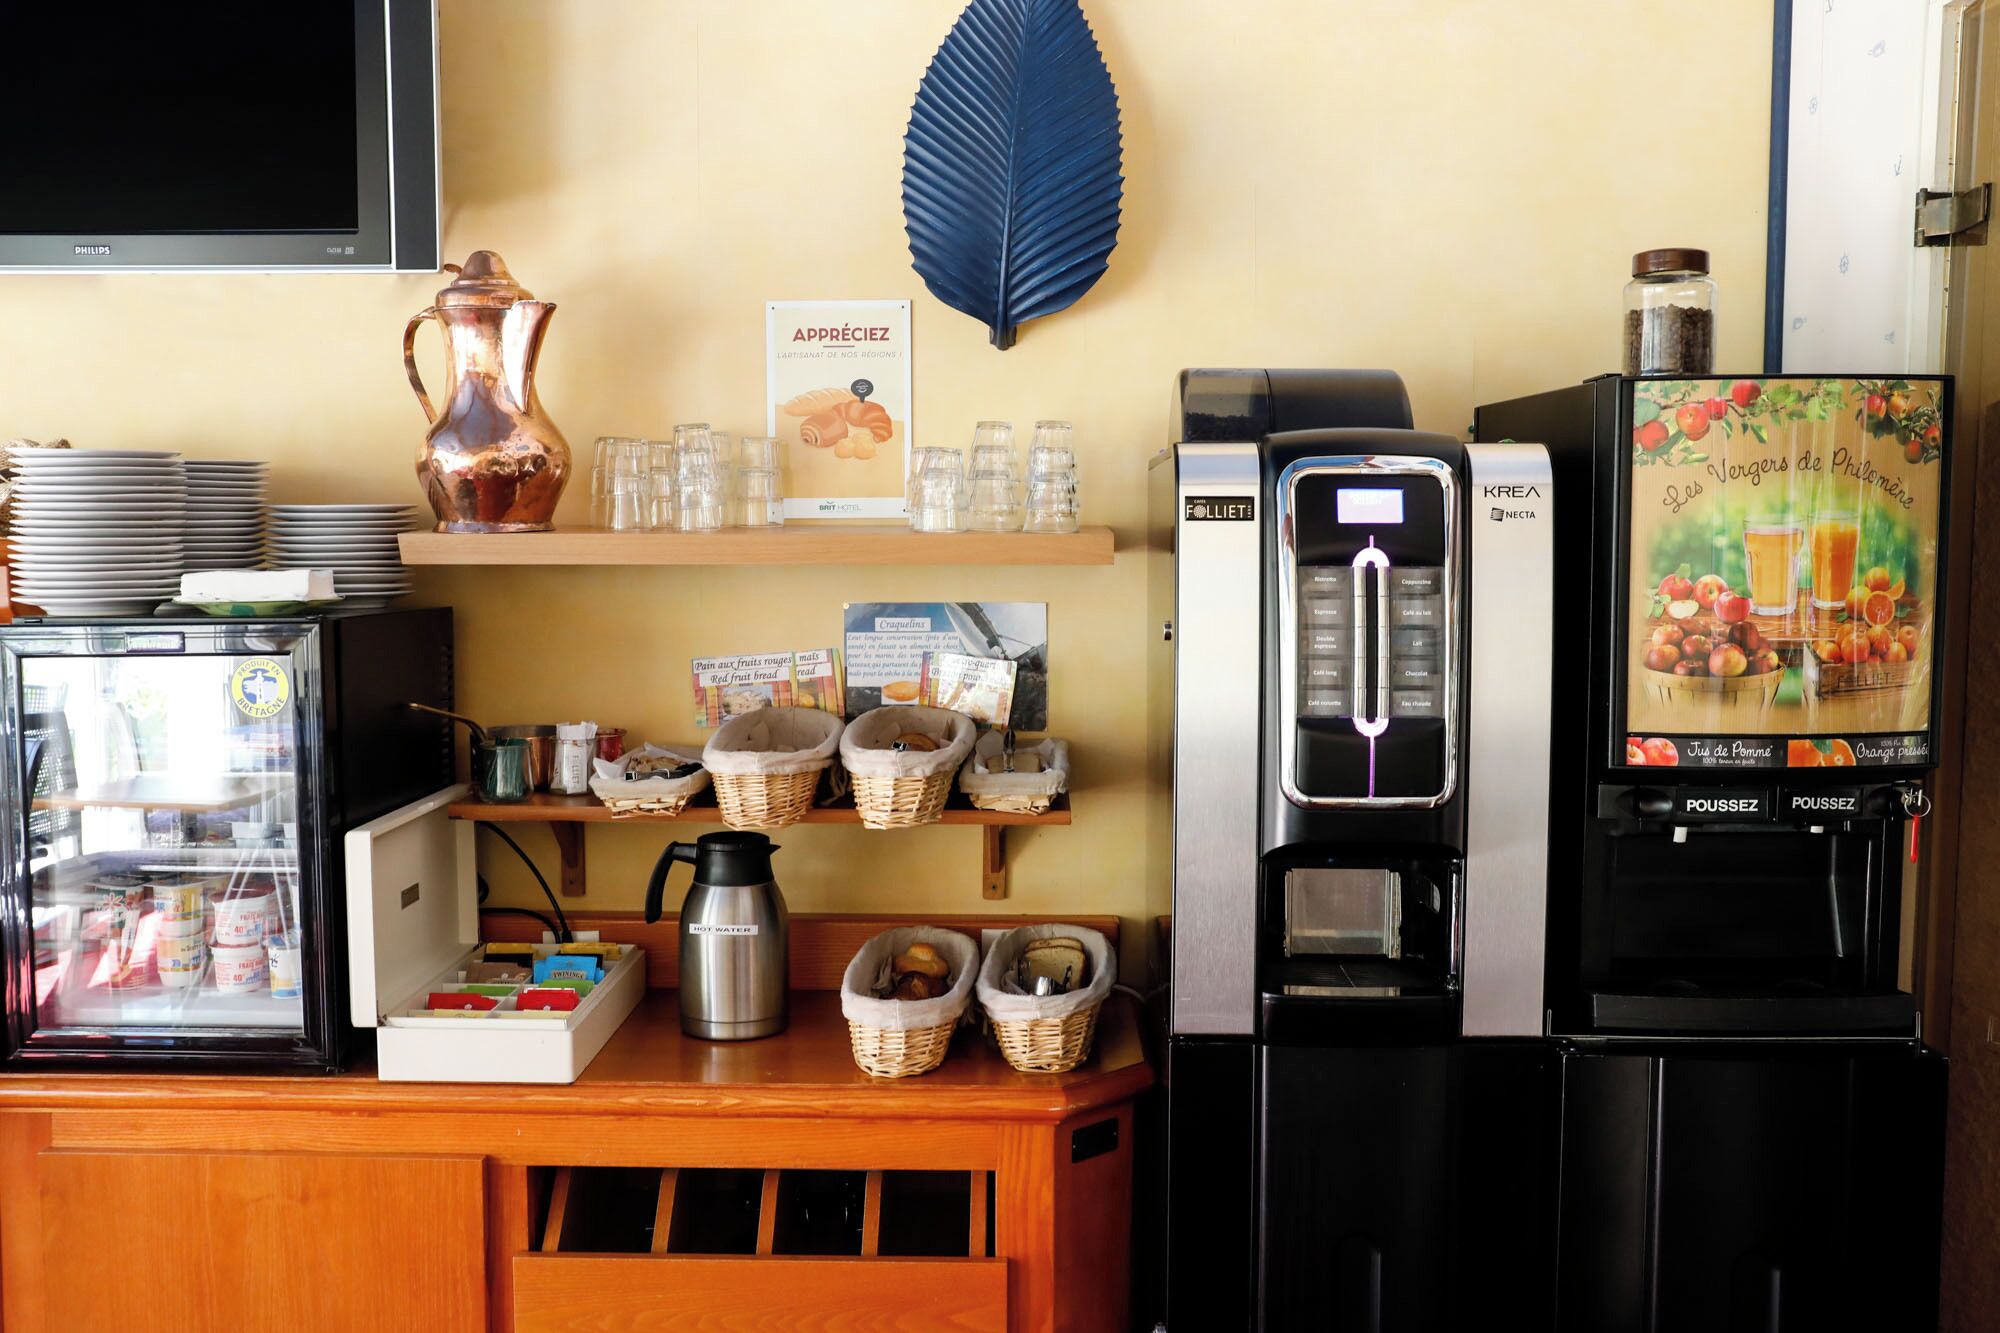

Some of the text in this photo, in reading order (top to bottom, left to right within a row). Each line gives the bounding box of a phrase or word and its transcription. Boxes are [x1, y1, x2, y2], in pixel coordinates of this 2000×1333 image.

[75, 246, 110, 255] PHILIPS
[793, 322, 890, 342] APPRÉCIEZ
[777, 350, 824, 359] L'ARTISANAT
[827, 351, 838, 359] DE
[841, 351, 858, 359] NOS
[861, 350, 897, 358] RÉGIONS
[1662, 447, 1915, 514] Les Vergers de Philomène
[1505, 511, 1536, 519] NECTA
[880, 619, 925, 631] Craquelins
[695, 655, 792, 671] Pain aux fruits rouges
[799, 653, 820, 662] maïs
[238, 660, 271, 677] PRODUIT
[797, 665, 816, 676] read
[710, 669, 779, 684] Red fruit bread
[237, 697, 285, 716] BRETAGNE
[1687, 741, 1710, 757] Jus
[1713, 744, 1729, 757] de
[1856, 742, 1895, 763] Orange
[1686, 799, 1759, 813] POUSSEZ
[1792, 796, 1856, 811] POUSSEZ
